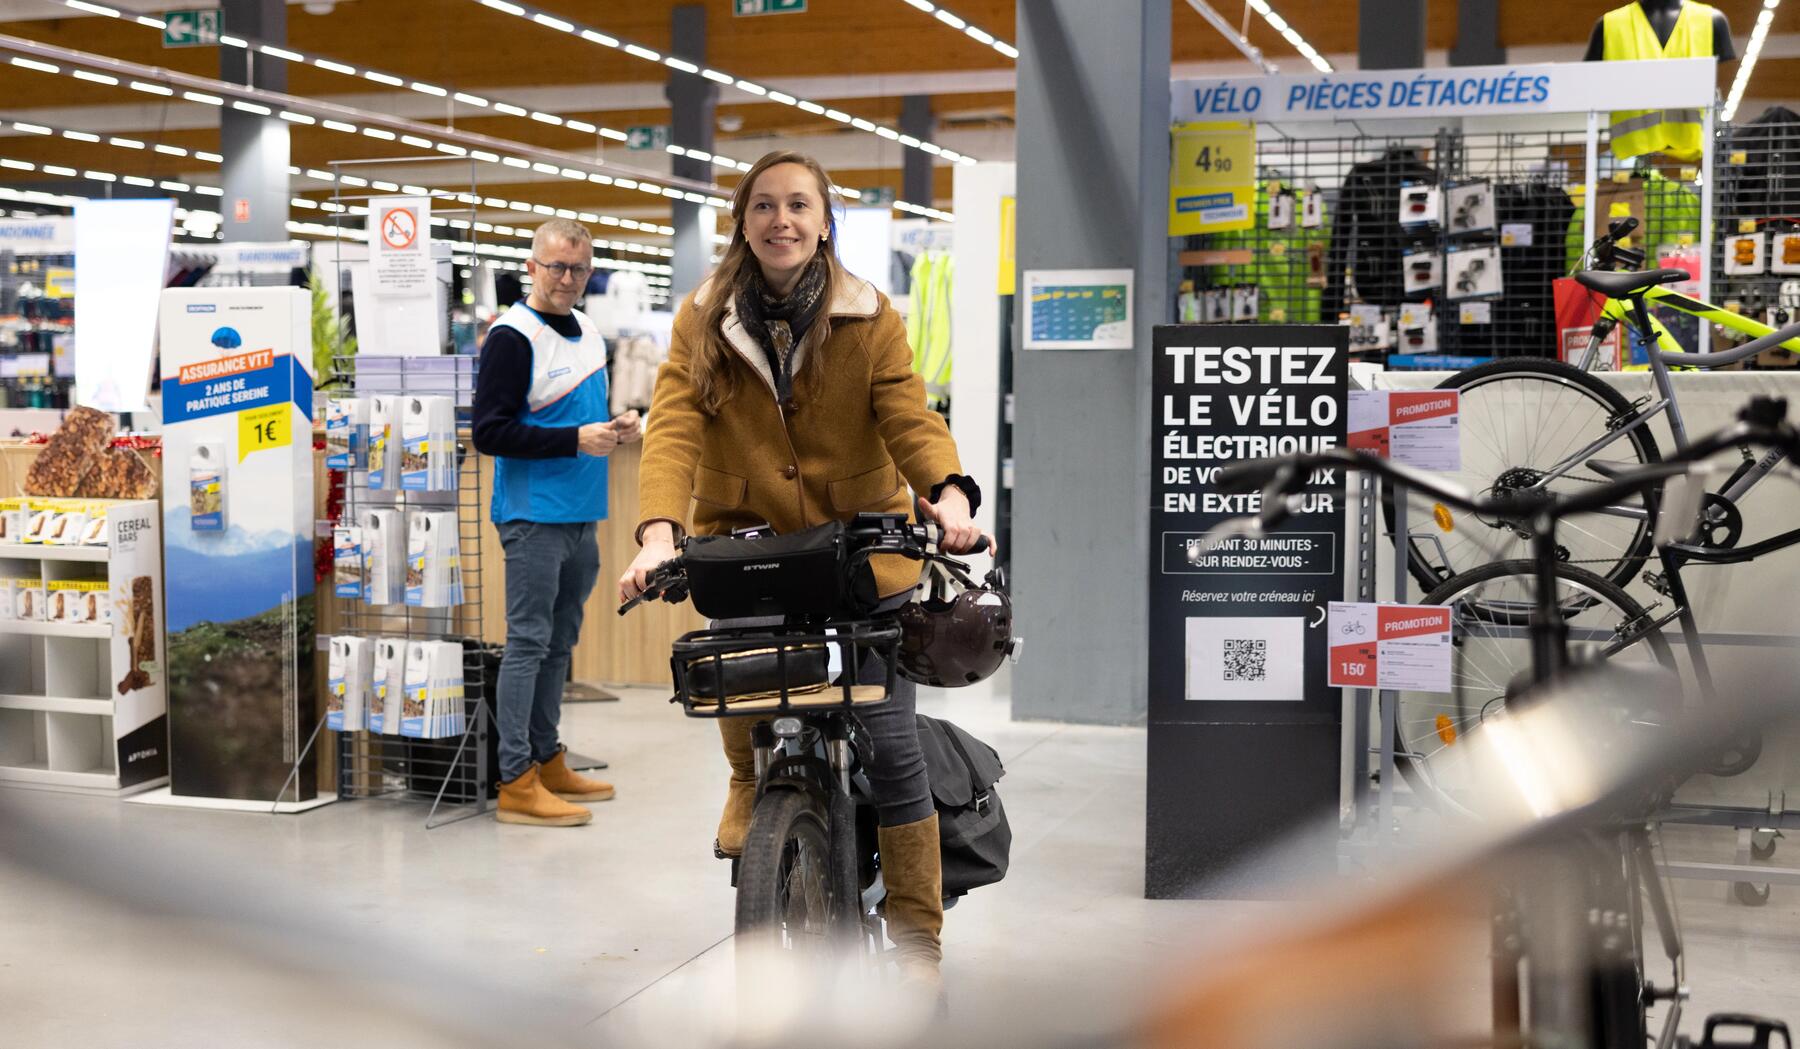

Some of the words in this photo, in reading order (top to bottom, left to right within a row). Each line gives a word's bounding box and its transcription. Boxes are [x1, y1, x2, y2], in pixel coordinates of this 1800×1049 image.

[1194, 82, 1262, 114] VÉLO
[1287, 78, 1382, 111] PIÈCES
[1388, 71, 1550, 107] DÉTACHÉES
[182, 356, 246, 382] ASSURANCE
[248, 351, 271, 368] VTT
[1165, 346, 1336, 385] TESTEZ
[205, 384, 212, 396] 2
[213, 380, 232, 395] ANS
[233, 378, 245, 391] DE
[186, 394, 231, 412] PRATIQUE
[231, 386, 269, 404] SEREINE
[1164, 395, 1212, 426] LE
[1228, 388, 1338, 426] VÉLO
[1396, 399, 1451, 417] PROMOTION
[1163, 430, 1337, 460] ÉLECTRIQUE
[1163, 467, 1191, 485] DE
[1164, 493, 1196, 513] EN
[1203, 490, 1334, 513] EXTÉUR
[117, 518, 151, 533] CEREAL
[118, 532, 138, 544] BARS
[1243, 539, 1257, 551] 30
[1260, 539, 1312, 551] MINUTES
[1195, 556, 1219, 568] SUR
[1222, 556, 1302, 568] RENDEZ-VOUS
[1182, 590, 1229, 602] Réservez
[1231, 591, 1257, 602] votre
[1259, 590, 1300, 602] créneau
[1302, 590, 1316, 602] ici
[1384, 616, 1442, 632] PROMOTION
